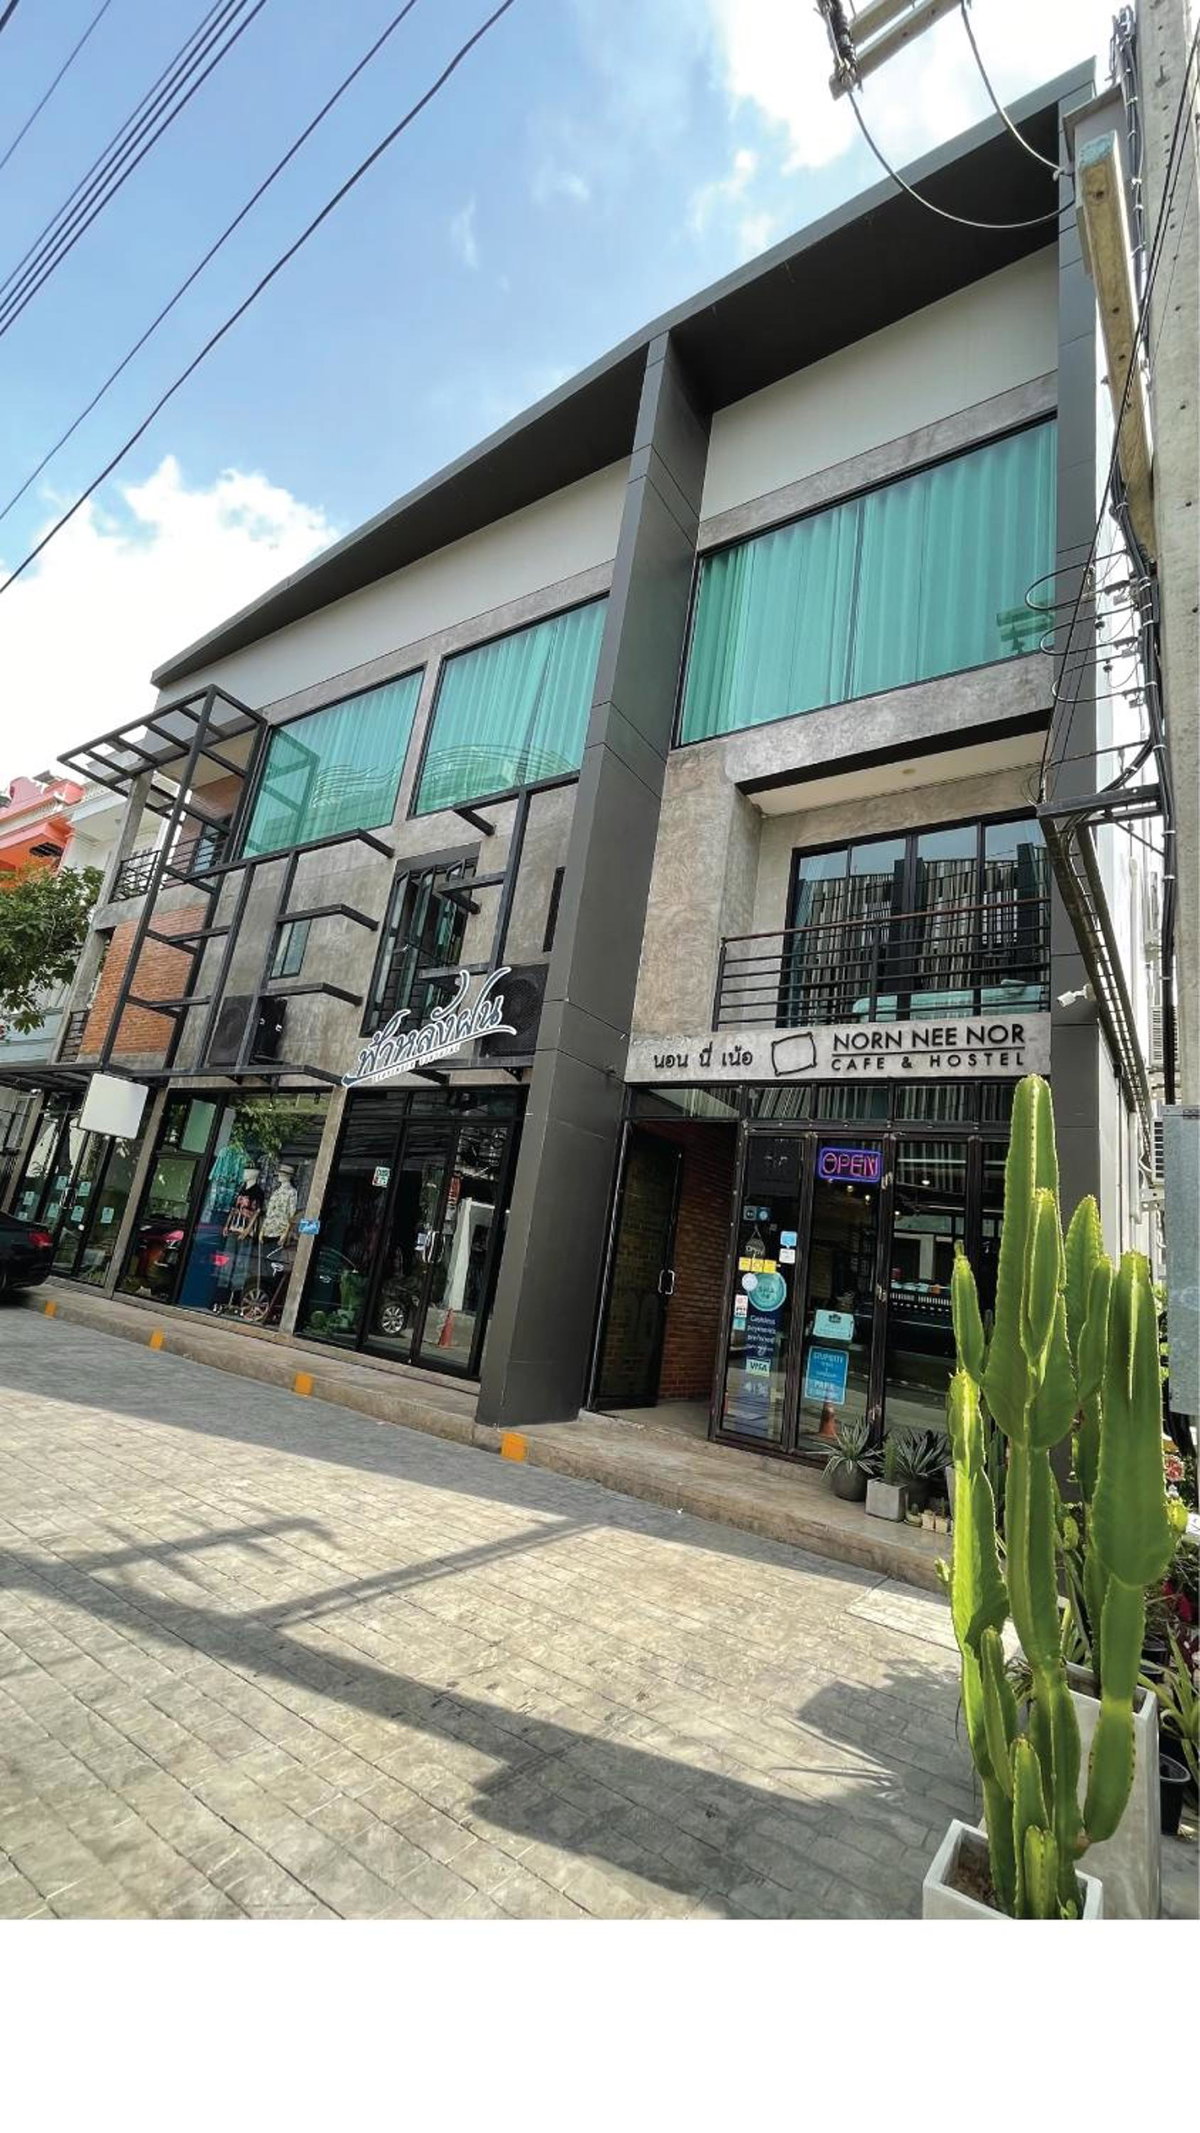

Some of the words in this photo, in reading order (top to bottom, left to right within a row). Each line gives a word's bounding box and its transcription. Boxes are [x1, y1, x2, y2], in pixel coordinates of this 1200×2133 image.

[354, 966, 512, 1080] ฟ้าหลังฝน
[833, 1030, 902, 1051] NORN
[912, 1027, 958, 1048] NEE
[966, 1023, 1025, 1045] NOR
[654, 1053, 690, 1069] นอน
[721, 1044, 753, 1067] เน้อ
[831, 1056, 886, 1071] CAFE
[901, 1055, 913, 1069] &
[929, 1051, 1025, 1068] HOSTEL
[822, 1152, 880, 1178] OPEN
[750, 1361, 767, 1371] VISA
